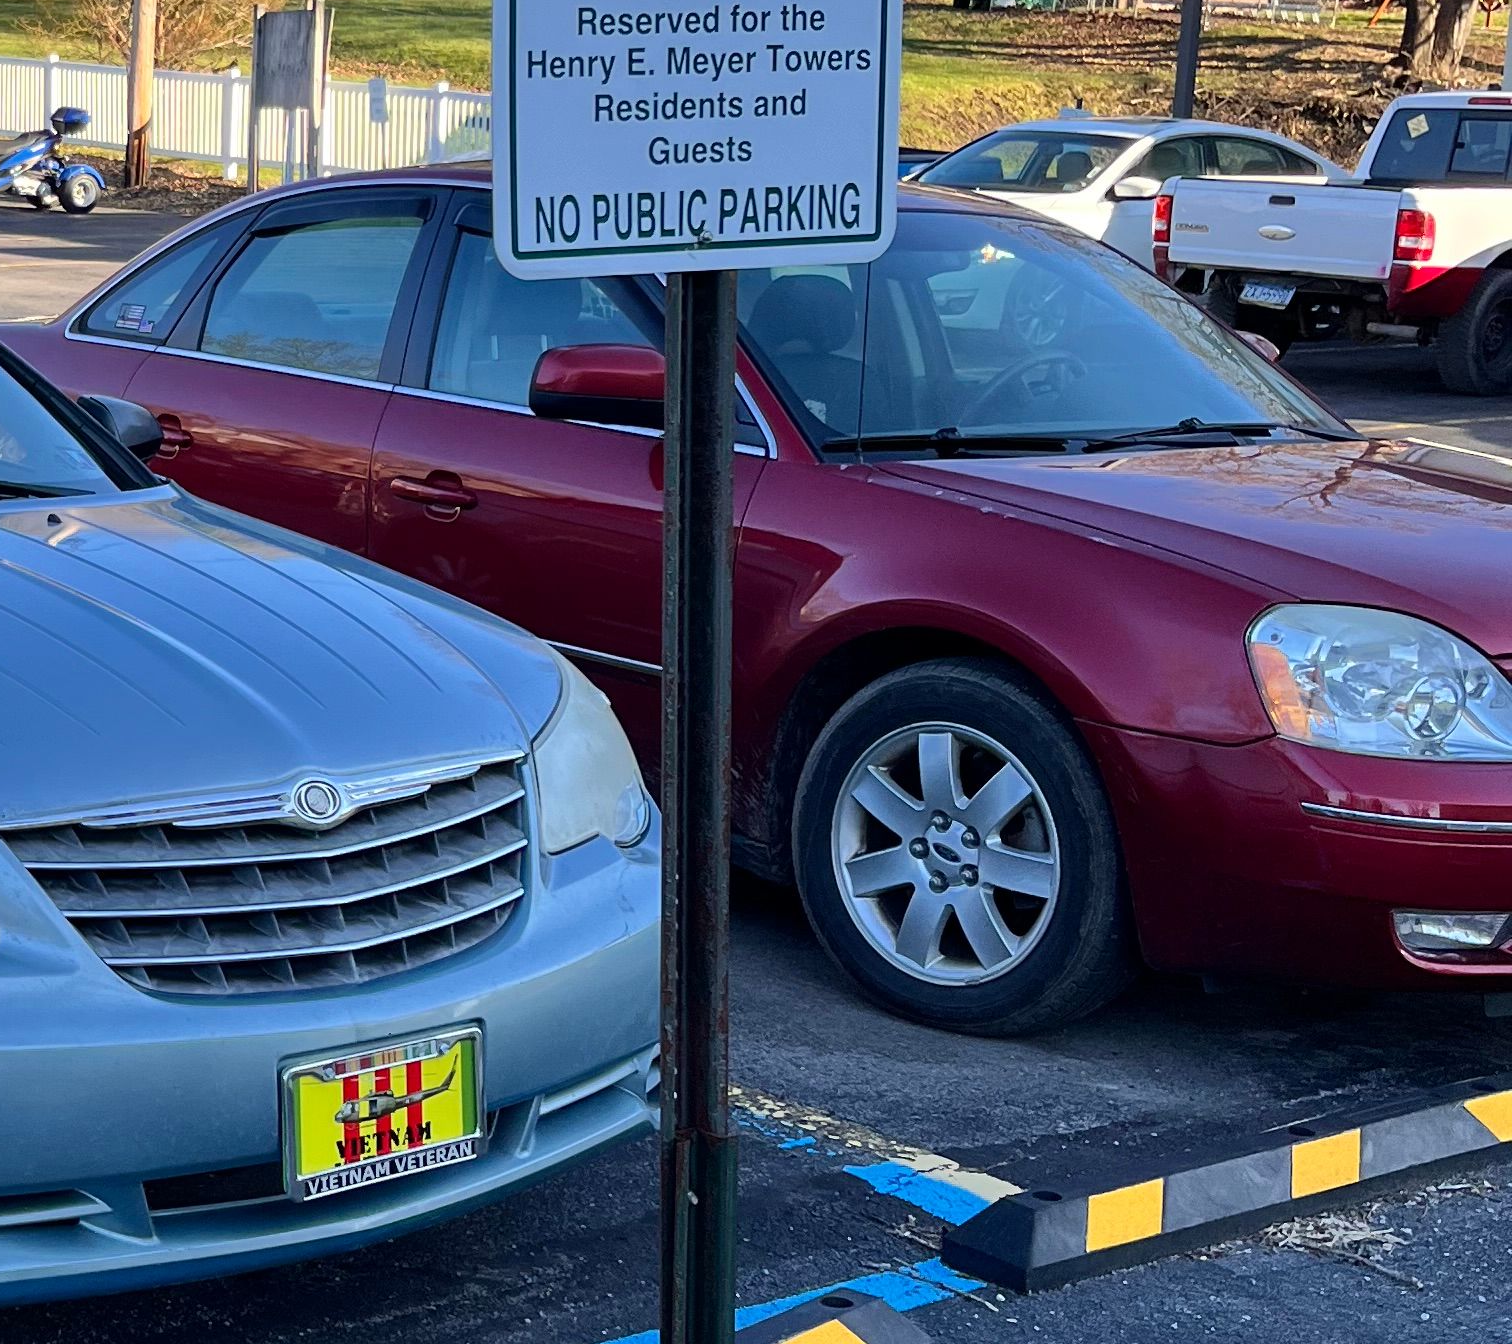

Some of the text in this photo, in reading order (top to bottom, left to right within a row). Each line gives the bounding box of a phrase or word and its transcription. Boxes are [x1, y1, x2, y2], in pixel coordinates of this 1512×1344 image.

[577, 3, 825, 36] Reserved for the
[527, 44, 871, 85] Henry E. Meyer Towers
[594, 88, 807, 123] Residents and
[648, 136, 753, 166] Guests
[535, 182, 861, 244] NO PUBLIC PARKING
[336, 1121, 431, 1158] VIETNAM
[308, 1140, 473, 1195] VIETNAM VETERAN
